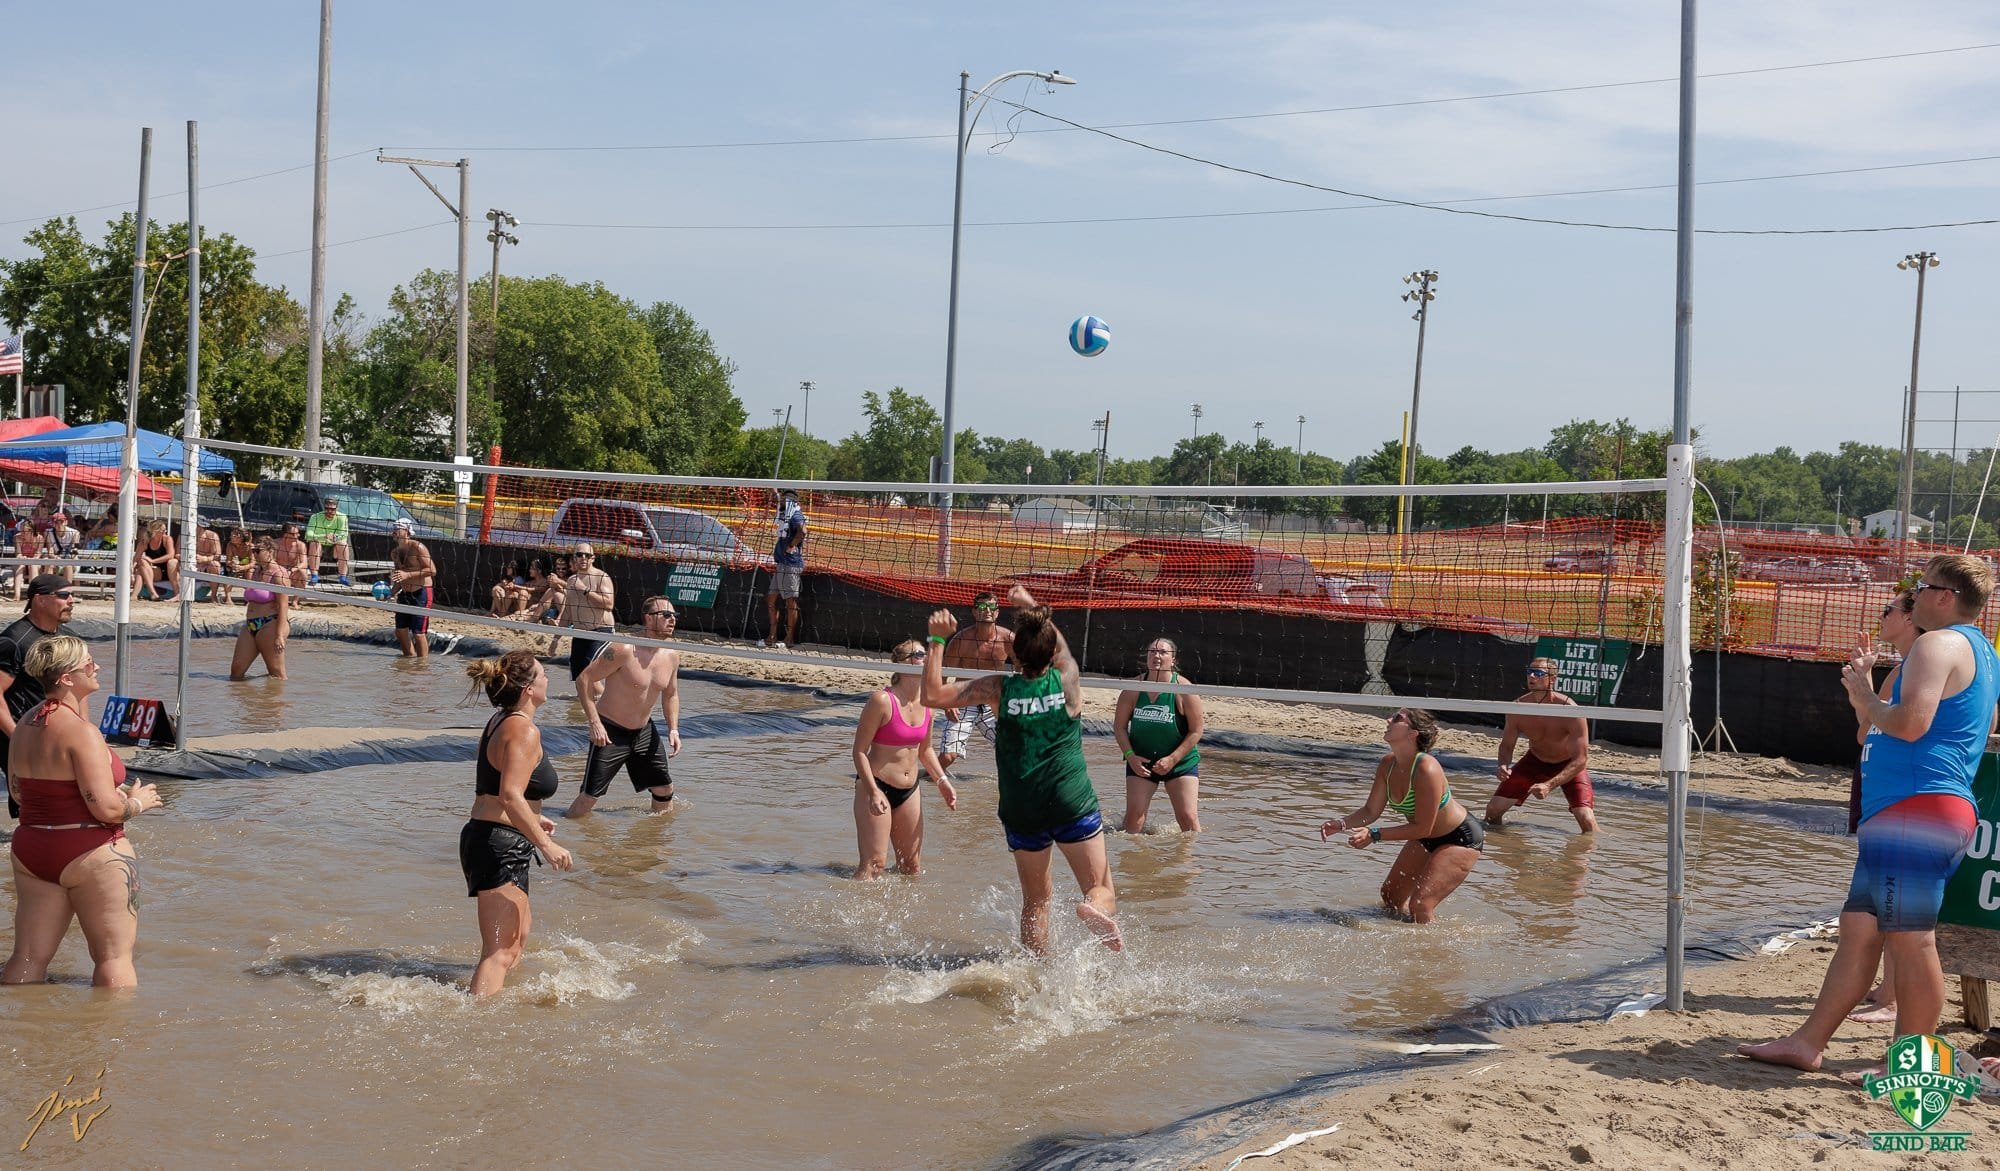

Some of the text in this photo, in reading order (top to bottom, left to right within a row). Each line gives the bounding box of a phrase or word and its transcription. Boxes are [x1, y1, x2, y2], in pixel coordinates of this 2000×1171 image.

[668, 574, 721, 591] CHAMPIONSHIP
[678, 589, 701, 602] COURT
[1554, 677, 1602, 696] COURT
[1007, 692, 1066, 716] STAFF
[102, 701, 126, 730] 33
[131, 704, 156, 735] 39
[1884, 884, 1896, 922] Hurley
